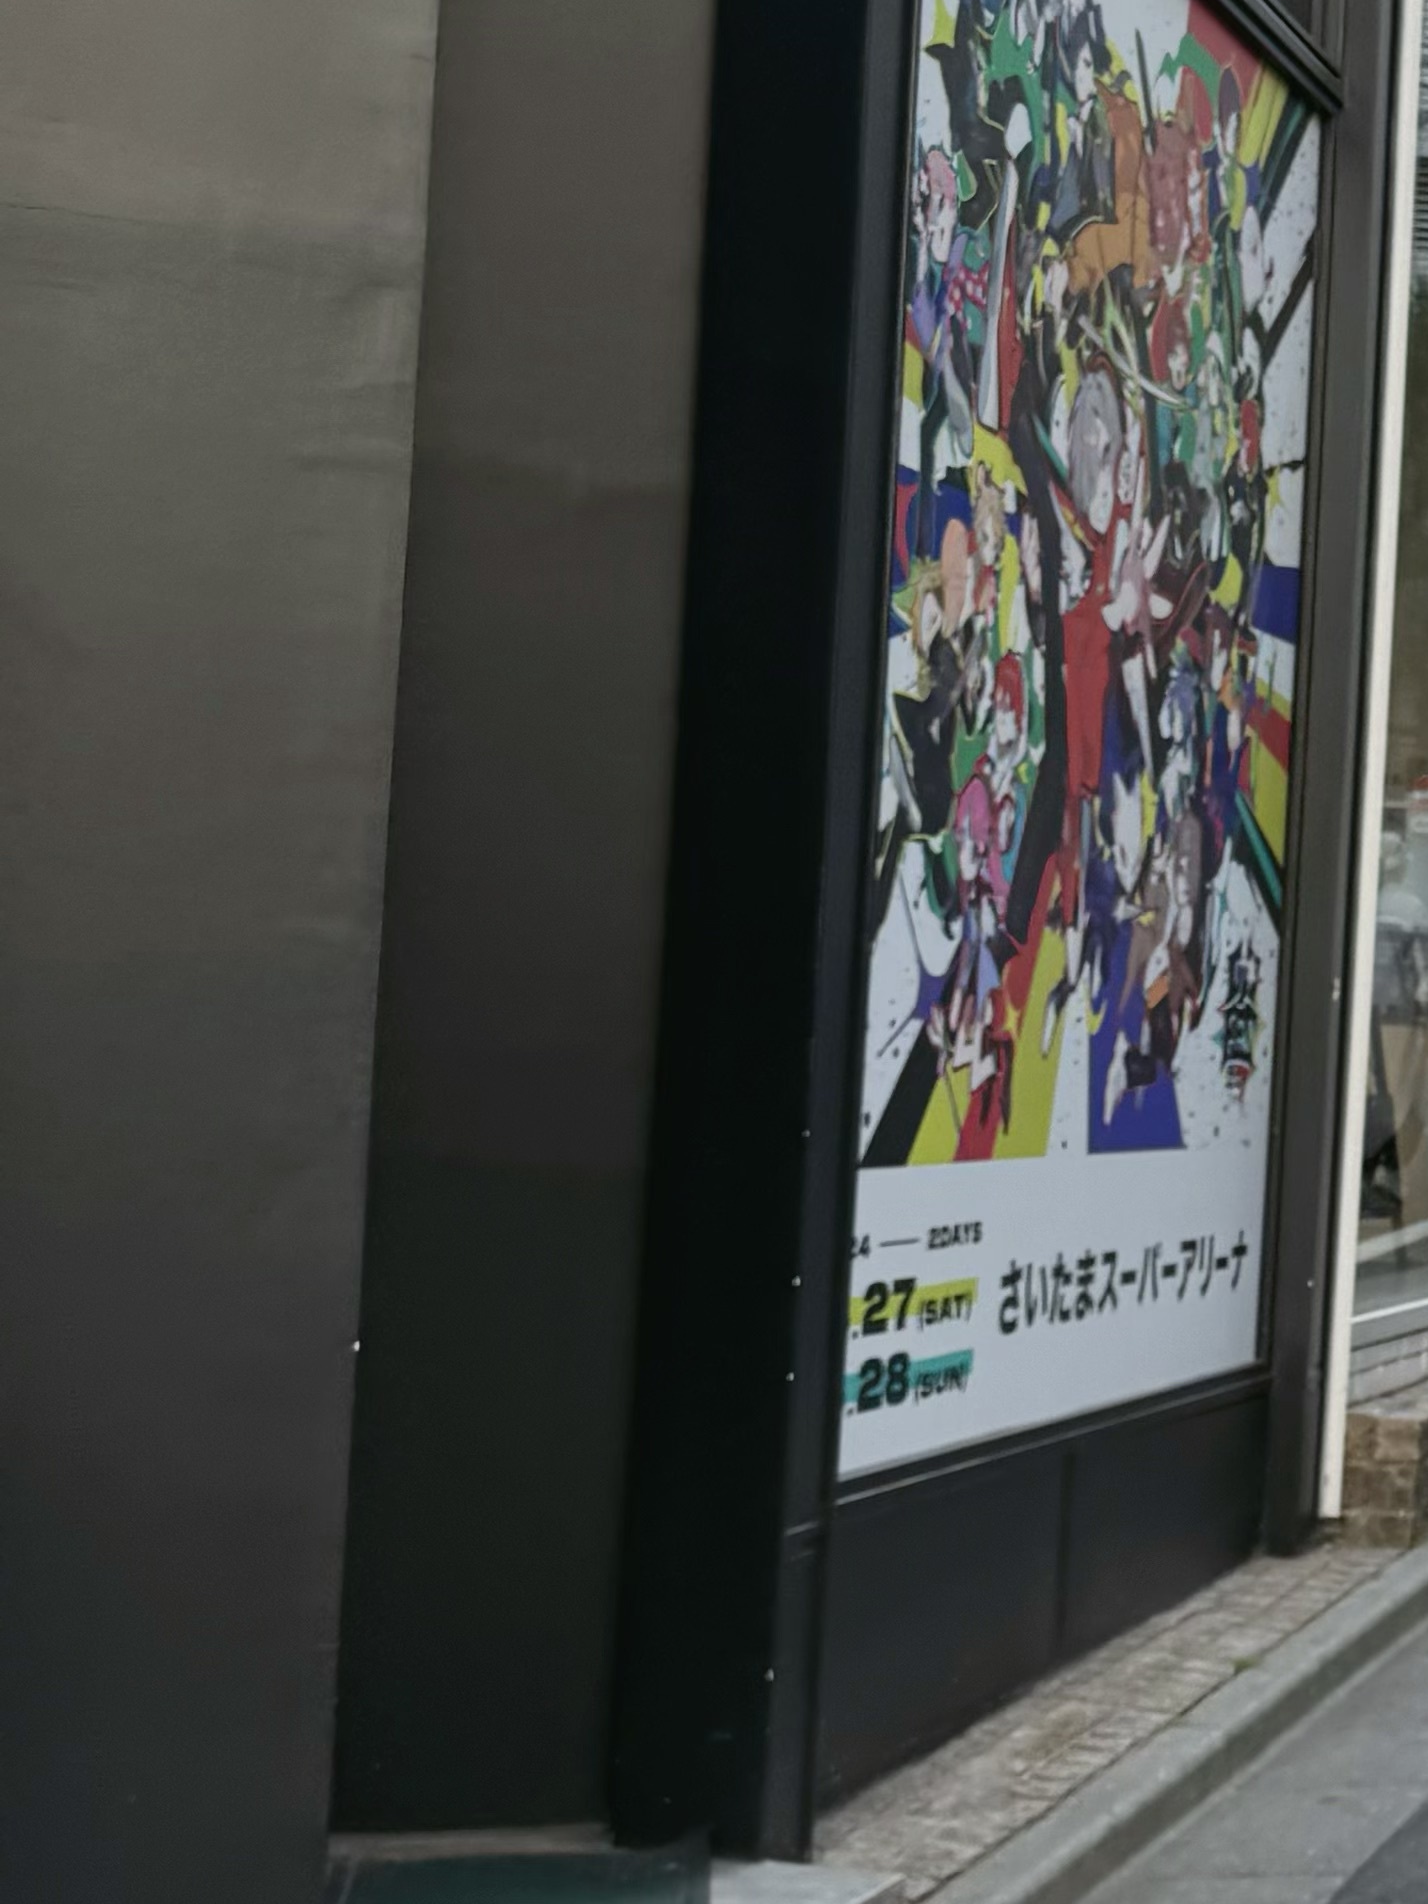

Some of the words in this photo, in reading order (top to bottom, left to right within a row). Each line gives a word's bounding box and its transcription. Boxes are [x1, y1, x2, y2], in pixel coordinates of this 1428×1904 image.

[999, 1228, 1248, 1336] さいたまスーパーアリーナ
